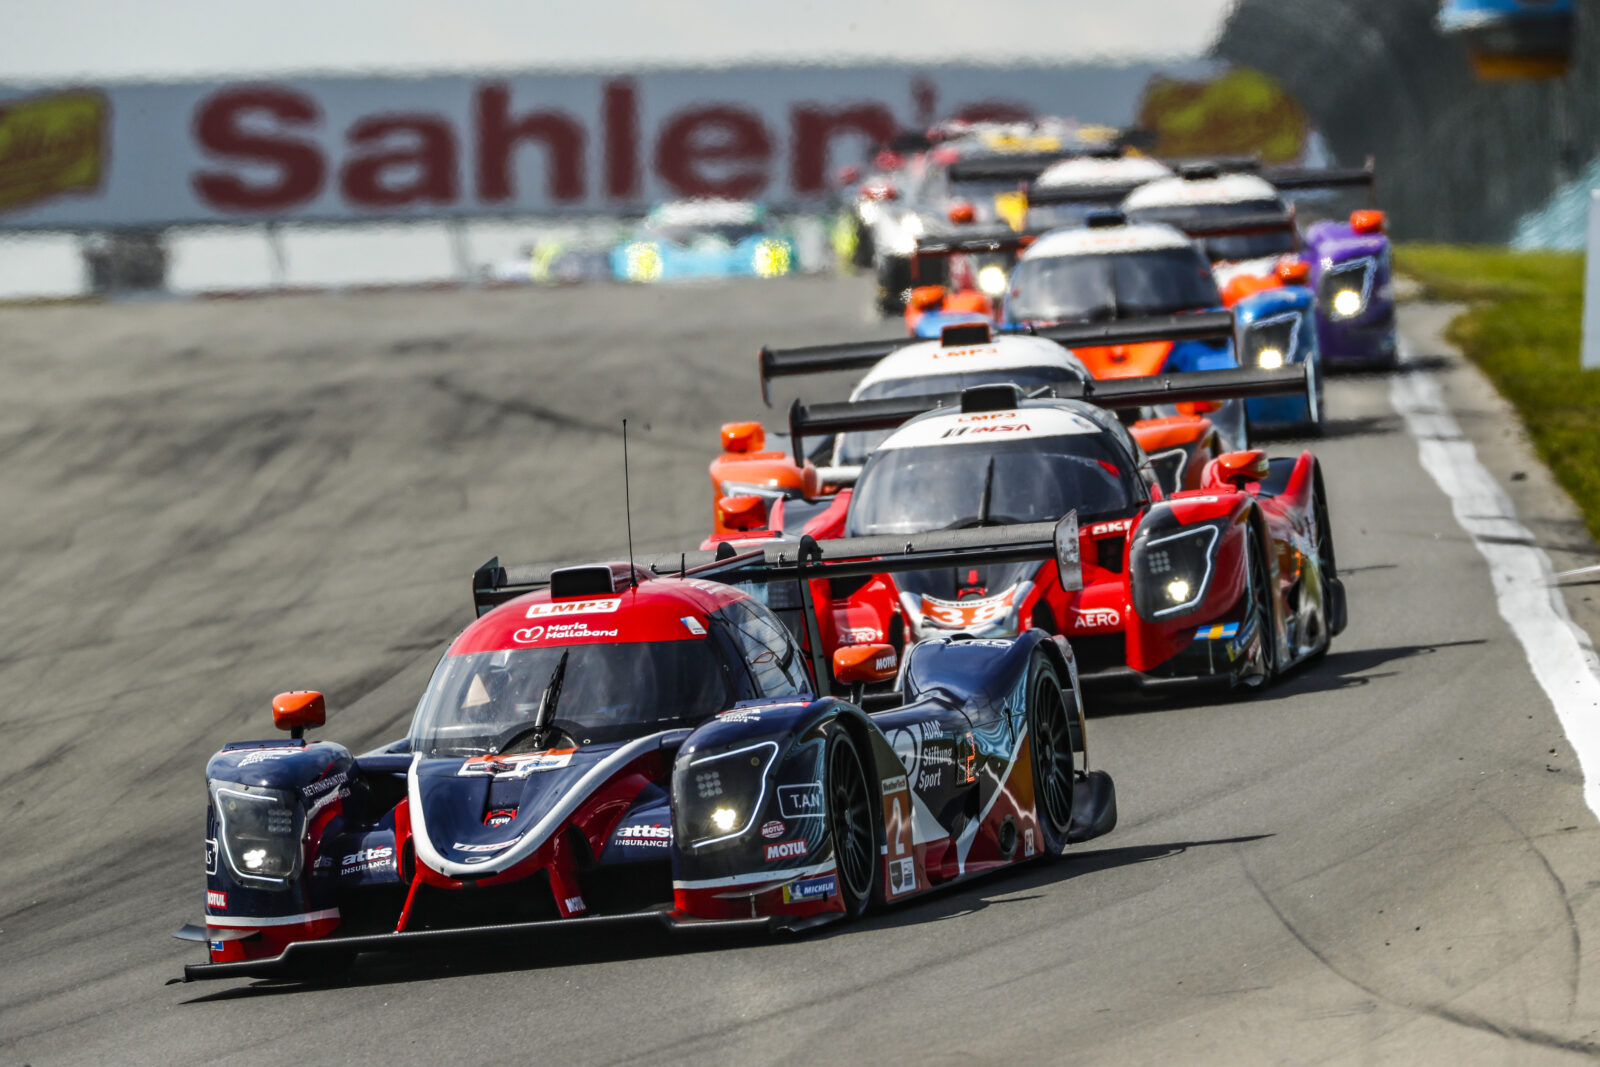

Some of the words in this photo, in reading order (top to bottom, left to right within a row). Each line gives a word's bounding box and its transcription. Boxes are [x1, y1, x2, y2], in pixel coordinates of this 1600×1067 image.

[190, 73, 1036, 213] Sahlen'
[933, 348, 998, 359] LMP3
[958, 412, 1016, 422] LMP3
[532, 601, 615, 616] LMP3
[931, 605, 1002, 626] 38
[547, 622, 588, 631] Maria
[1074, 613, 1120, 629] AERO
[545, 628, 618, 639] Mallaband
[921, 720, 944, 740] ADAC
[922, 746, 953, 767] Stiftung
[918, 767, 942, 791] Sport
[490, 817, 511, 825] TOW
[893, 797, 905, 855] 2
[617, 824, 670, 838] attis
[762, 824, 785, 835] MOTUL
[615, 839, 669, 848] INSURANCE
[767, 841, 807, 859] MOTUL
[341, 845, 393, 866] attis
[341, 858, 392, 876] INSURANCE
[803, 882, 834, 895] MICHELIN
